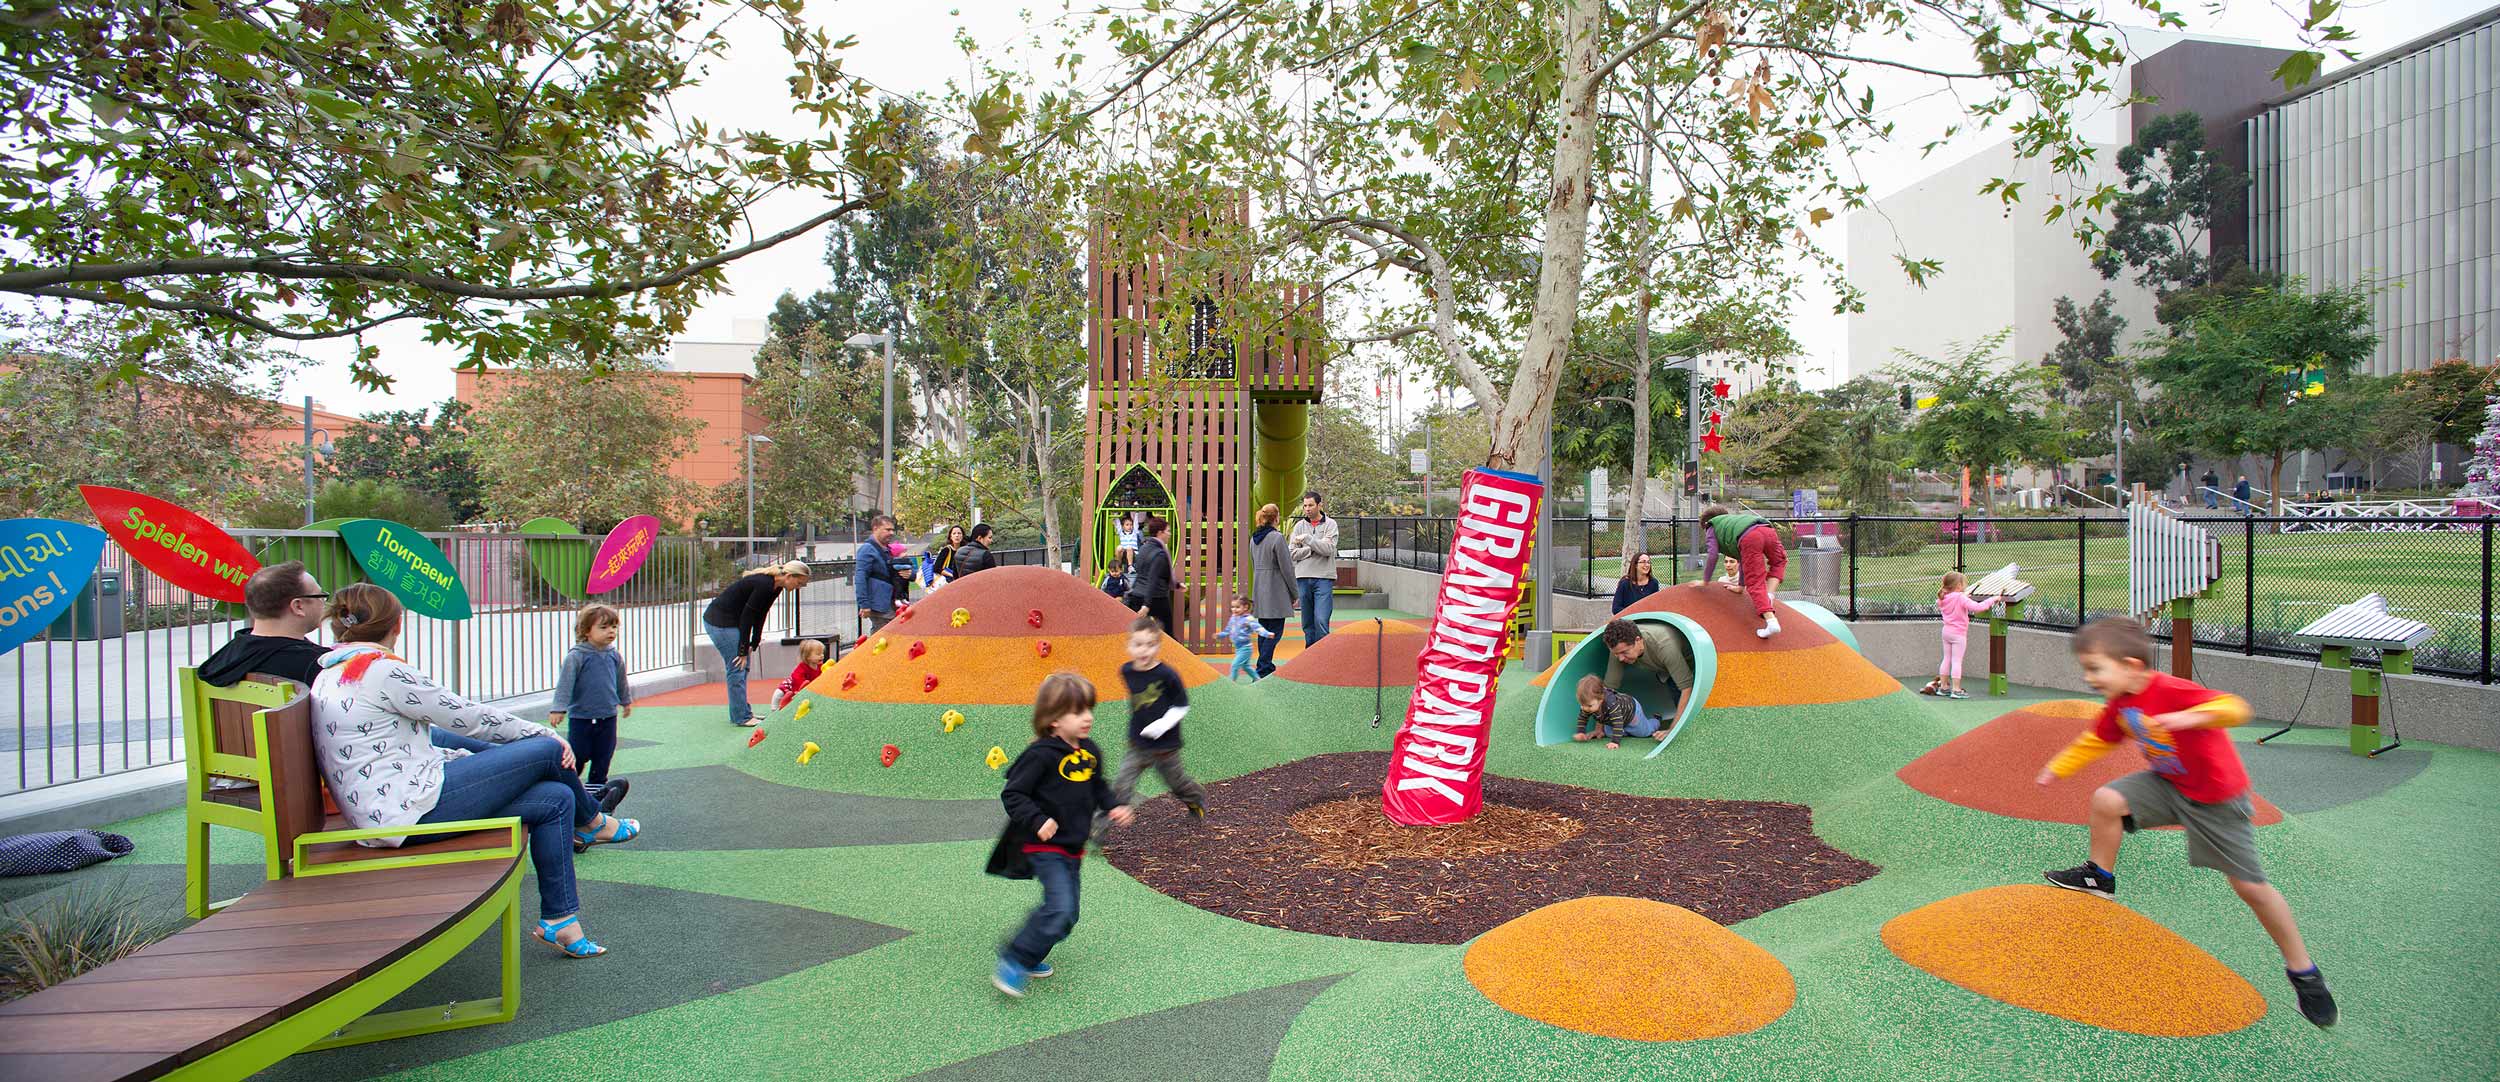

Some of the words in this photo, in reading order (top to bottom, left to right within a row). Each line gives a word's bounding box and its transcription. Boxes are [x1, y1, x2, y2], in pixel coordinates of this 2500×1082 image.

[122, 507, 208, 567] Spielen
[214, 558, 250, 586] wir
[366, 548, 399, 581] 함께
[376, 526, 454, 590] Поиграем!
[1433, 483, 1531, 662] GRAND
[1397, 663, 1489, 806] PARK
